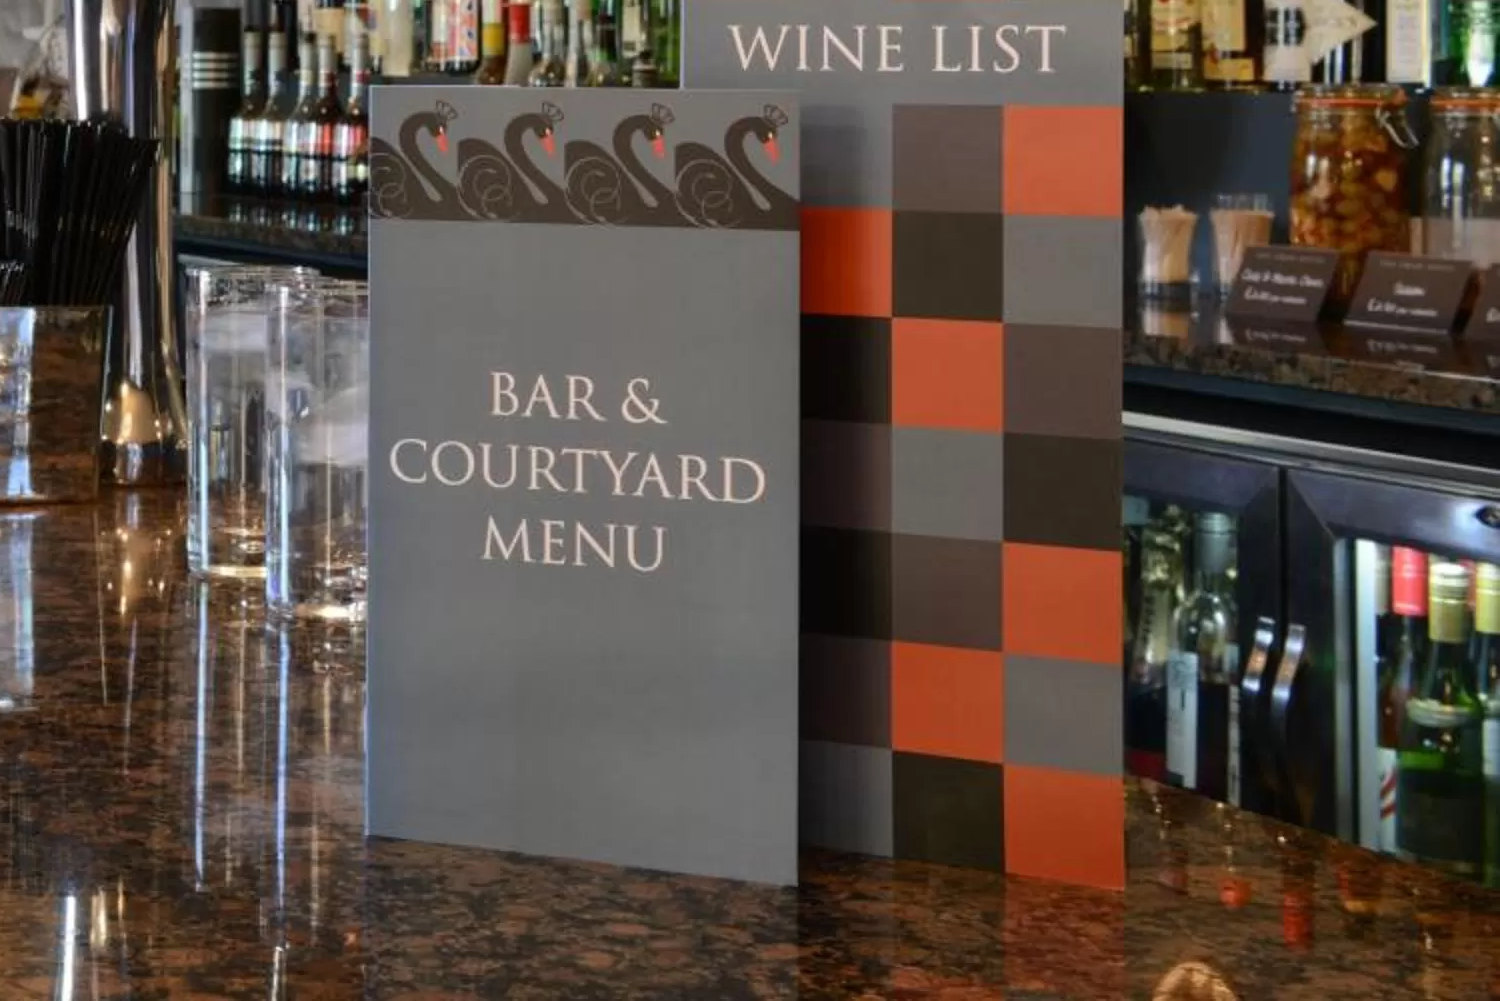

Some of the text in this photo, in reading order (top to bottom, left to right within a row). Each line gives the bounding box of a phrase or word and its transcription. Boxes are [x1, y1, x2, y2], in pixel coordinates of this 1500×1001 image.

[727, 24, 1067, 74] WINE LIST
[490, 371, 669, 424] BAR &
[389, 438, 767, 504] COURTYARD
[480, 514, 669, 573] MENU
